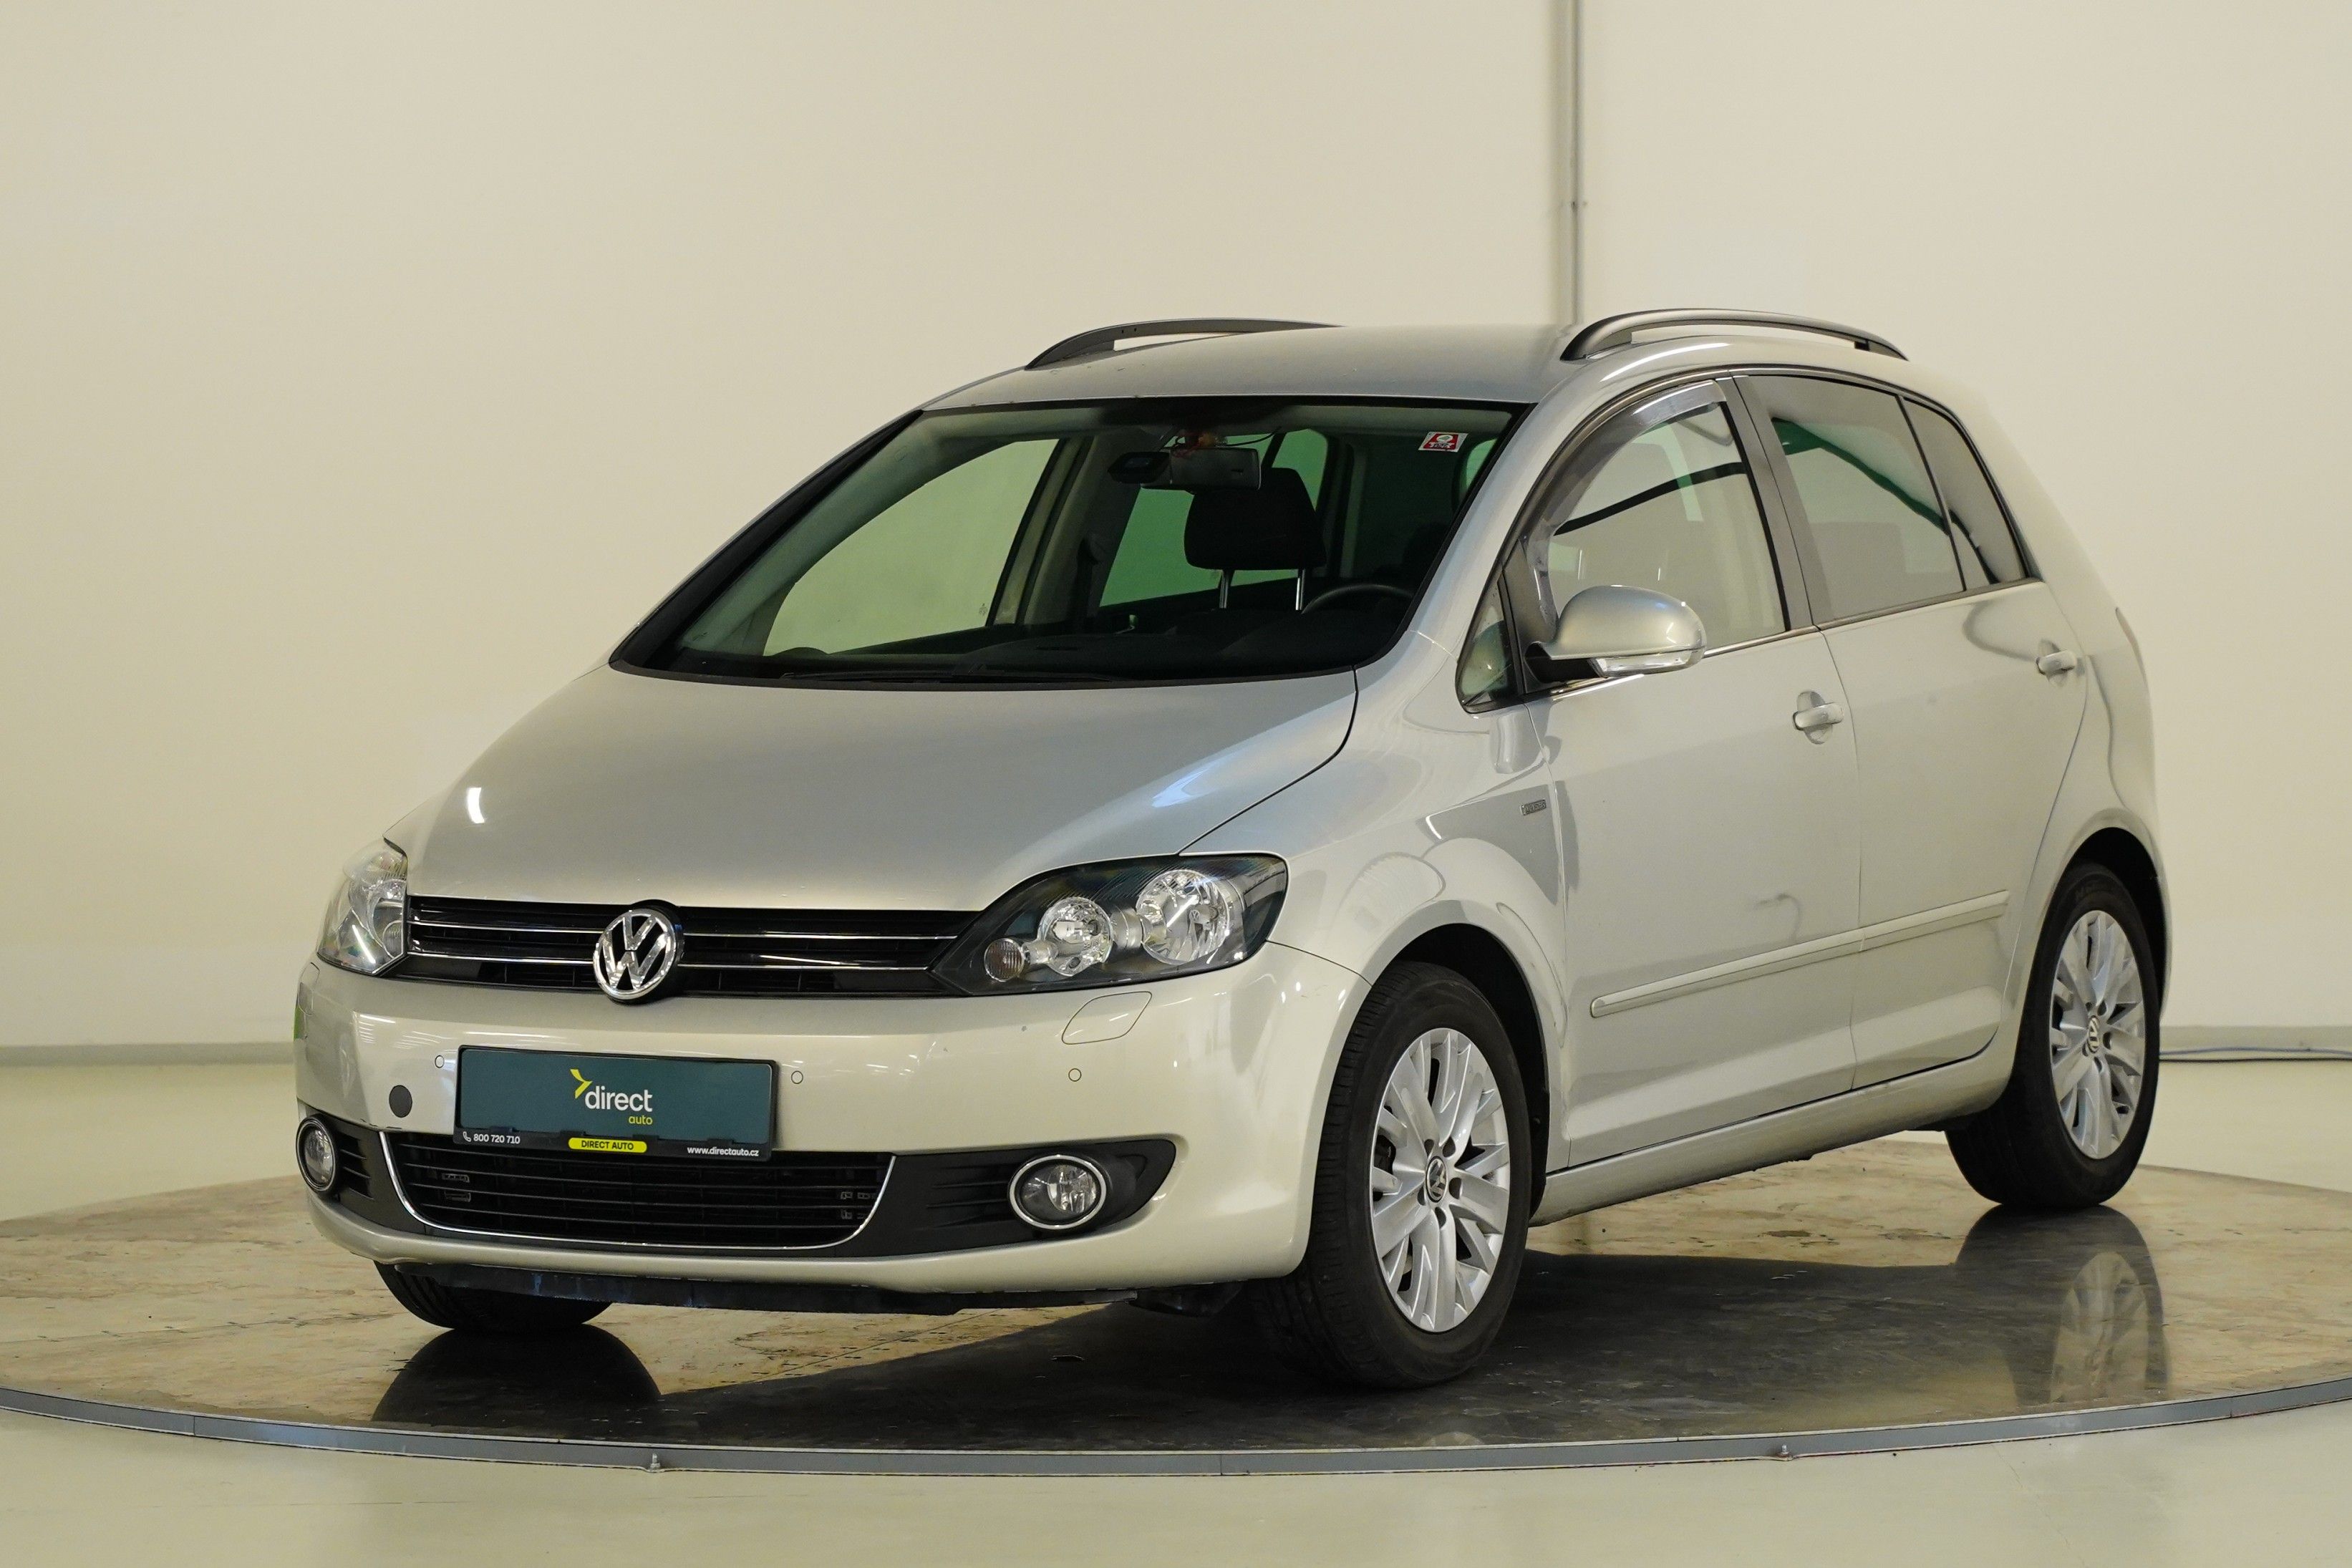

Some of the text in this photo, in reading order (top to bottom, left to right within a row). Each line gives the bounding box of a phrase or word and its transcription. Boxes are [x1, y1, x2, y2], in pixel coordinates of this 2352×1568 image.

[594, 909, 675, 1000] VW
[585, 1085, 653, 1112] direct
[628, 1115, 653, 1125] auto
[473, 1133, 521, 1144] 800 720 710
[581, 1140, 634, 1150] DIRECT AUTO
[687, 1146, 759, 1157] www.directauto.cz
